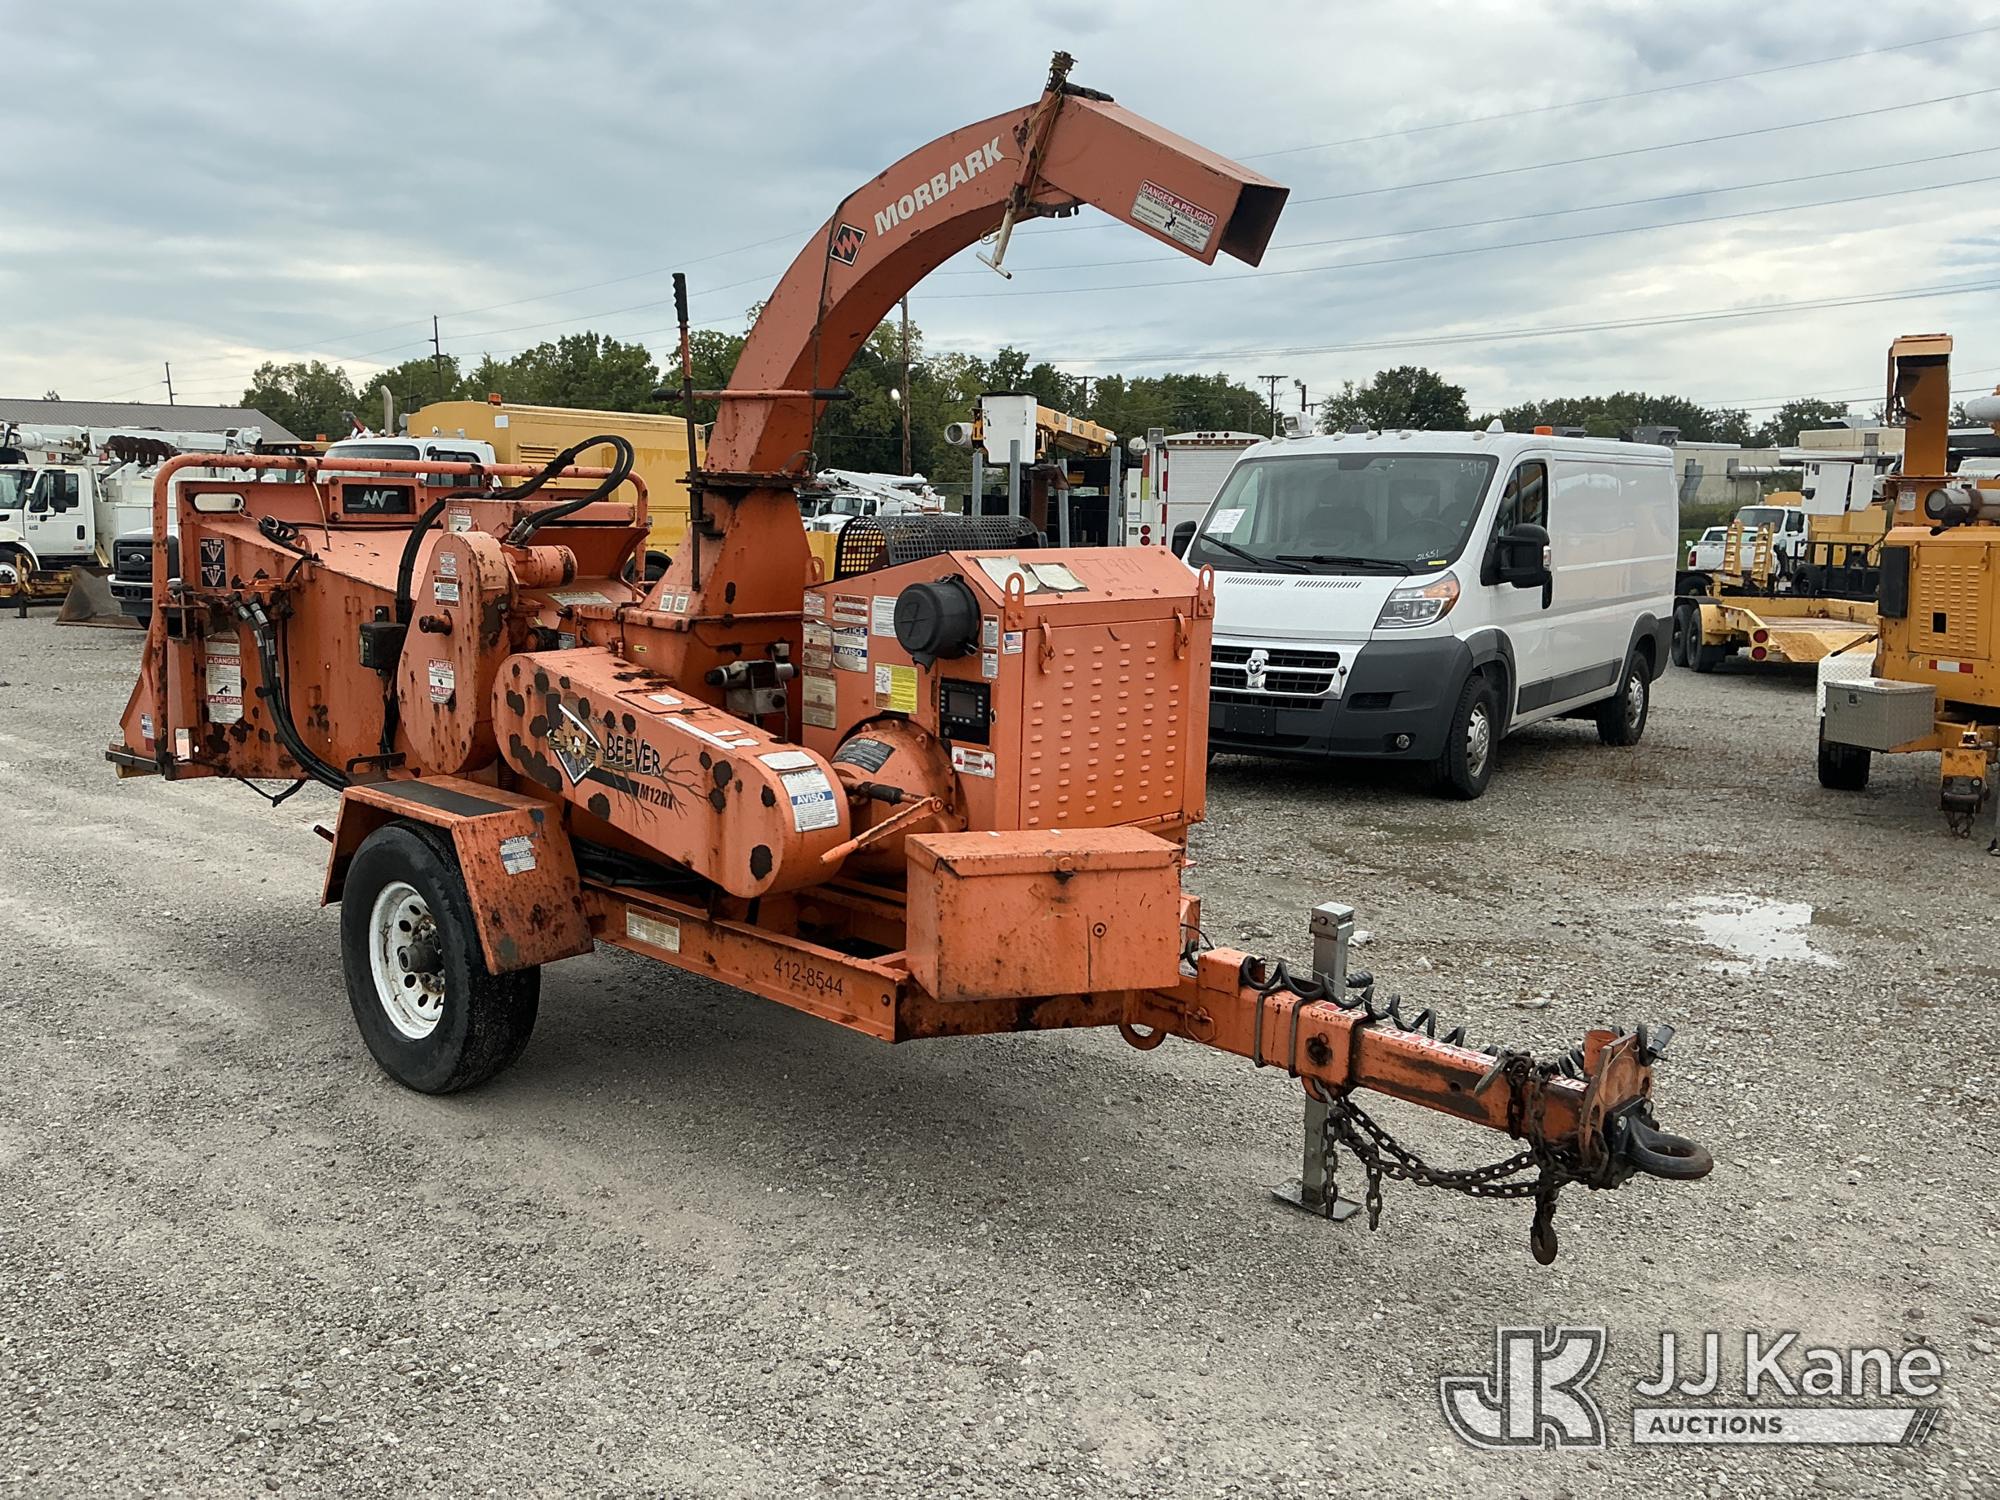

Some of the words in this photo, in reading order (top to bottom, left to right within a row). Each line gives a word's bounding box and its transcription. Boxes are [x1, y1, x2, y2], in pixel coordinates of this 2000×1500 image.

[874, 136, 1004, 236] MORBARK
[1142, 183, 1174, 205] DANGER
[1180, 204, 1214, 226] PELIGRO
[213, 657, 240, 665] DANGER
[838, 648, 863, 657] AVISO
[606, 732, 662, 776] BEEVER
[797, 792, 826, 804] AVISO
[773, 957, 843, 996] 412-8544
